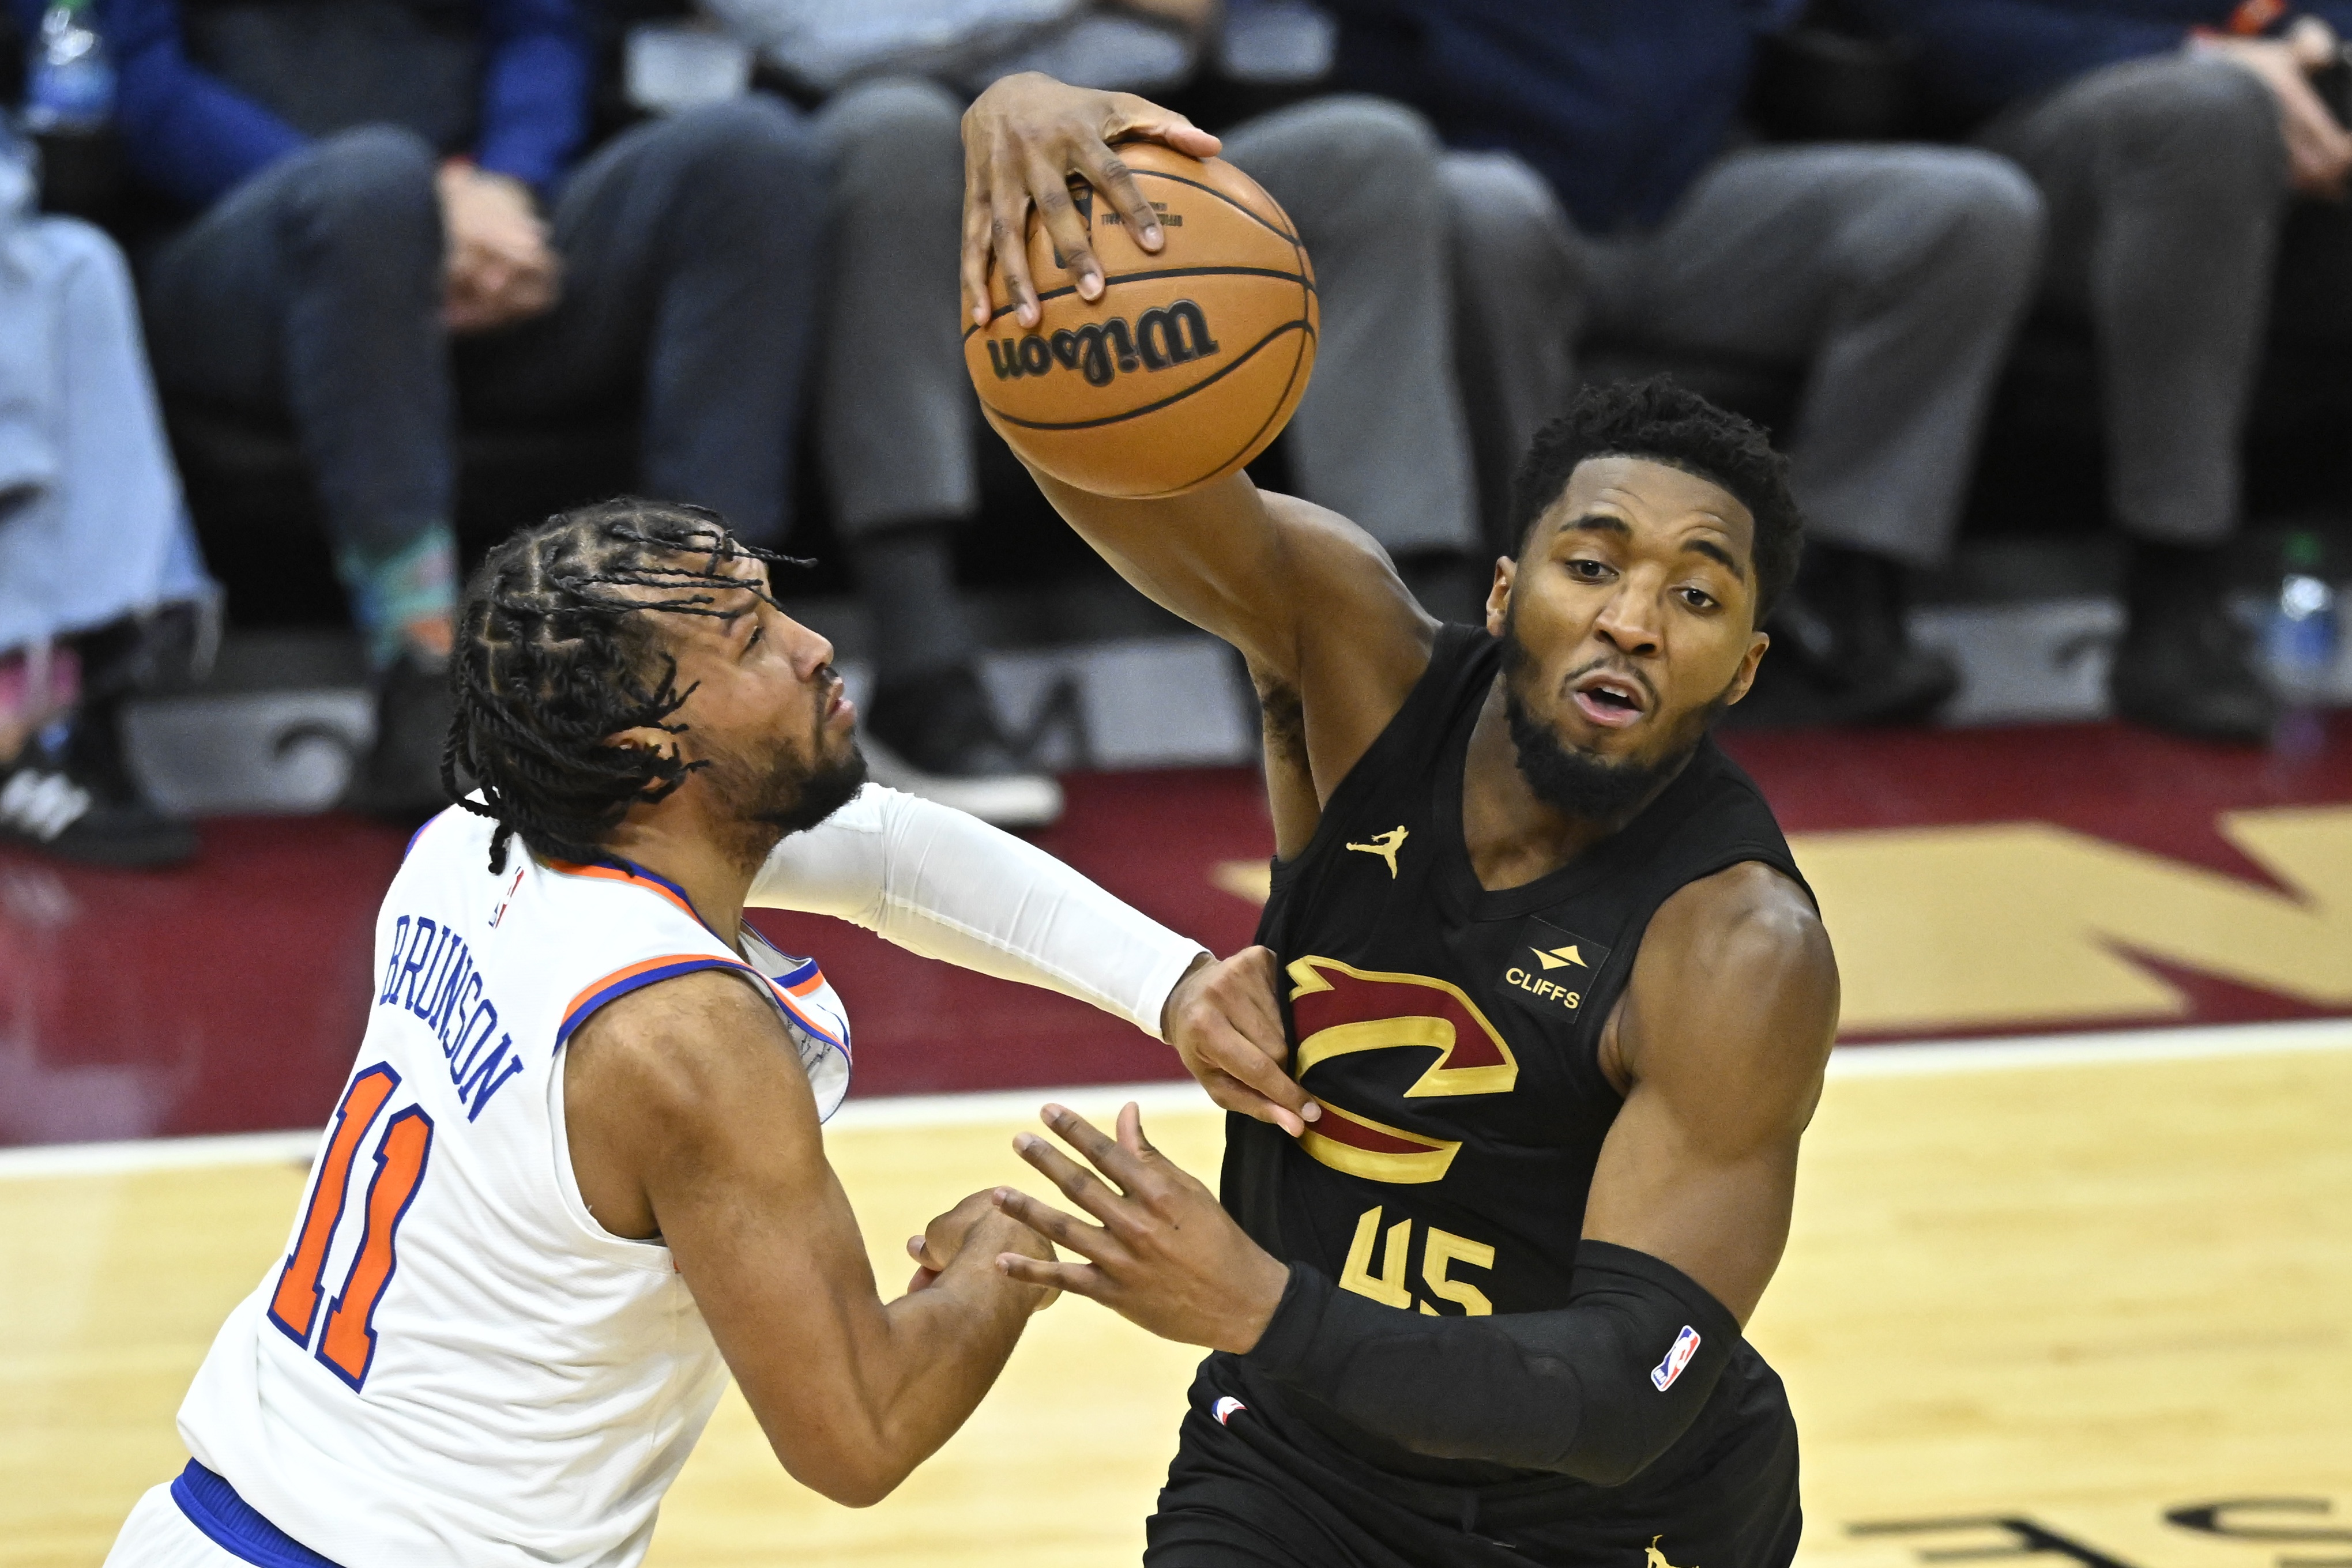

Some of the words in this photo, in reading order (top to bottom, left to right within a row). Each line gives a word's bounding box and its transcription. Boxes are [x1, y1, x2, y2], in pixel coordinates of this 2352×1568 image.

[987, 300, 1220, 386] Wilson
[380, 914, 524, 1123] BRUNSON
[1506, 967, 1580, 1009] CLIFFS
[266, 1061, 434, 1395] 11
[1339, 1205, 1495, 1317] 45
